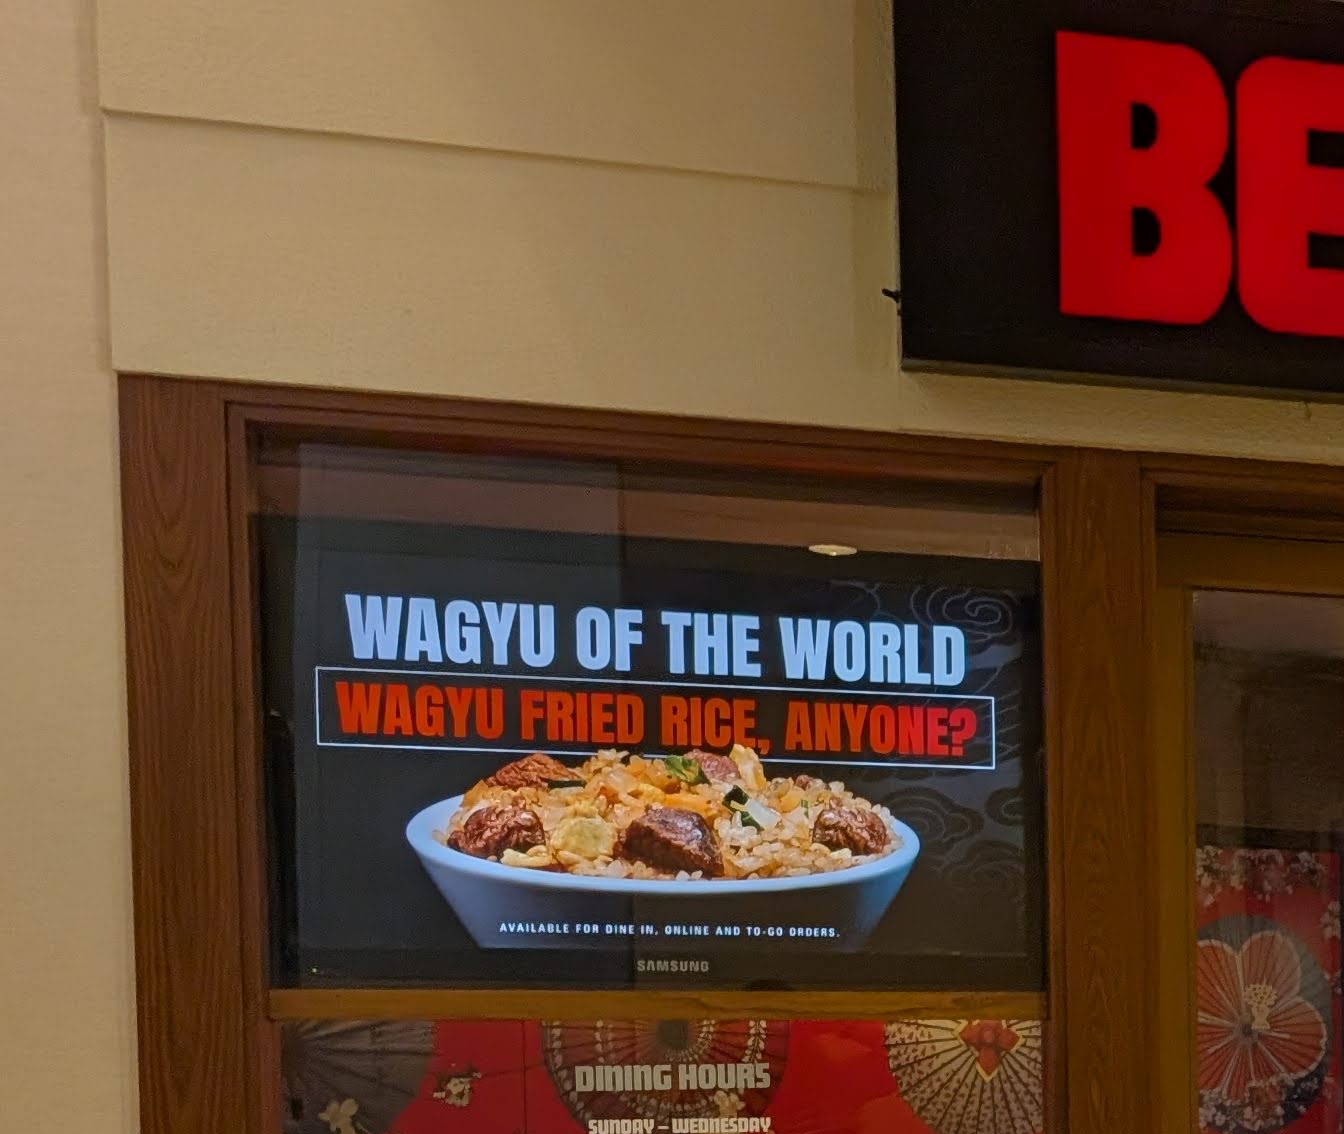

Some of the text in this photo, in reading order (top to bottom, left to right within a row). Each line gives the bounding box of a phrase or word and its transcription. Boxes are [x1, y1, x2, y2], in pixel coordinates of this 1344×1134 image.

[345, 592, 966, 687] WAGYU OF THE WORLD
[336, 680, 977, 758] WAGYU FRIED RICE, ANYONE?
[499, 922, 570, 934] AVAILABLE
[575, 923, 600, 935] FOR
[605, 923, 635, 936] DINE
[664, 925, 710, 936] ONLINE
[715, 925, 741, 937] AND
[746, 926, 784, 938] TO-GO
[789, 926, 841, 938] ORDERS.
[636, 959, 710, 973] SAMSUNG
[575, 1062, 771, 1092] DINING HOURS
[588, 1118, 655, 1134] SUNDAY
[671, 1116, 772, 1134] WEDNESDAY
